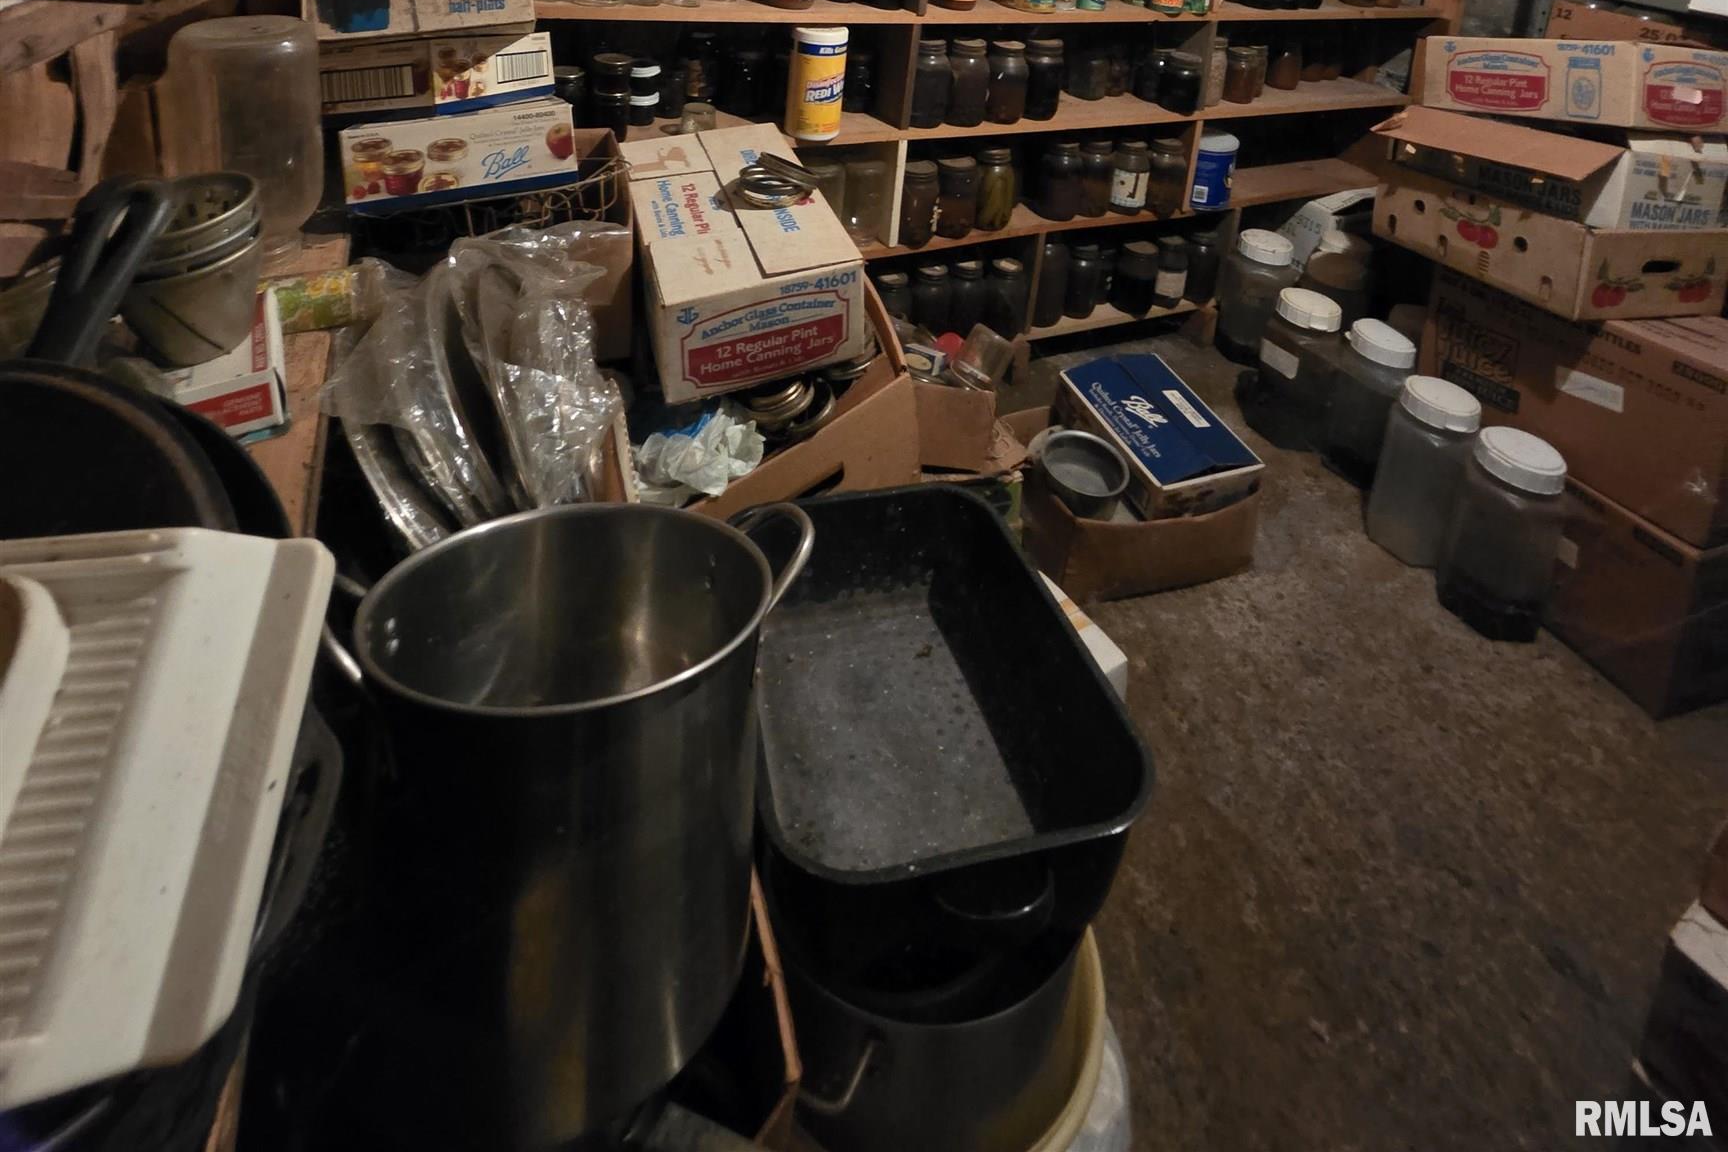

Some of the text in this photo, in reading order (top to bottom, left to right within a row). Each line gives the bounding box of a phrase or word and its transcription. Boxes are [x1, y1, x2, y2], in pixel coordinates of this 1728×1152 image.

[1556, 6, 1573, 21] 12
[1640, 26, 1661, 42] 25
[481, 145, 531, 179] Ball
[665, 202, 687, 236] Canning
[1631, 201, 1712, 225] MASON JARS
[701, 298, 837, 340] Anchor Glass Container
[749, 316, 790, 333] Mason
[700, 334, 834, 376] Home Canning Jars
[715, 325, 819, 360] 12 Regular Pint
[1120, 395, 1169, 428] Ball
